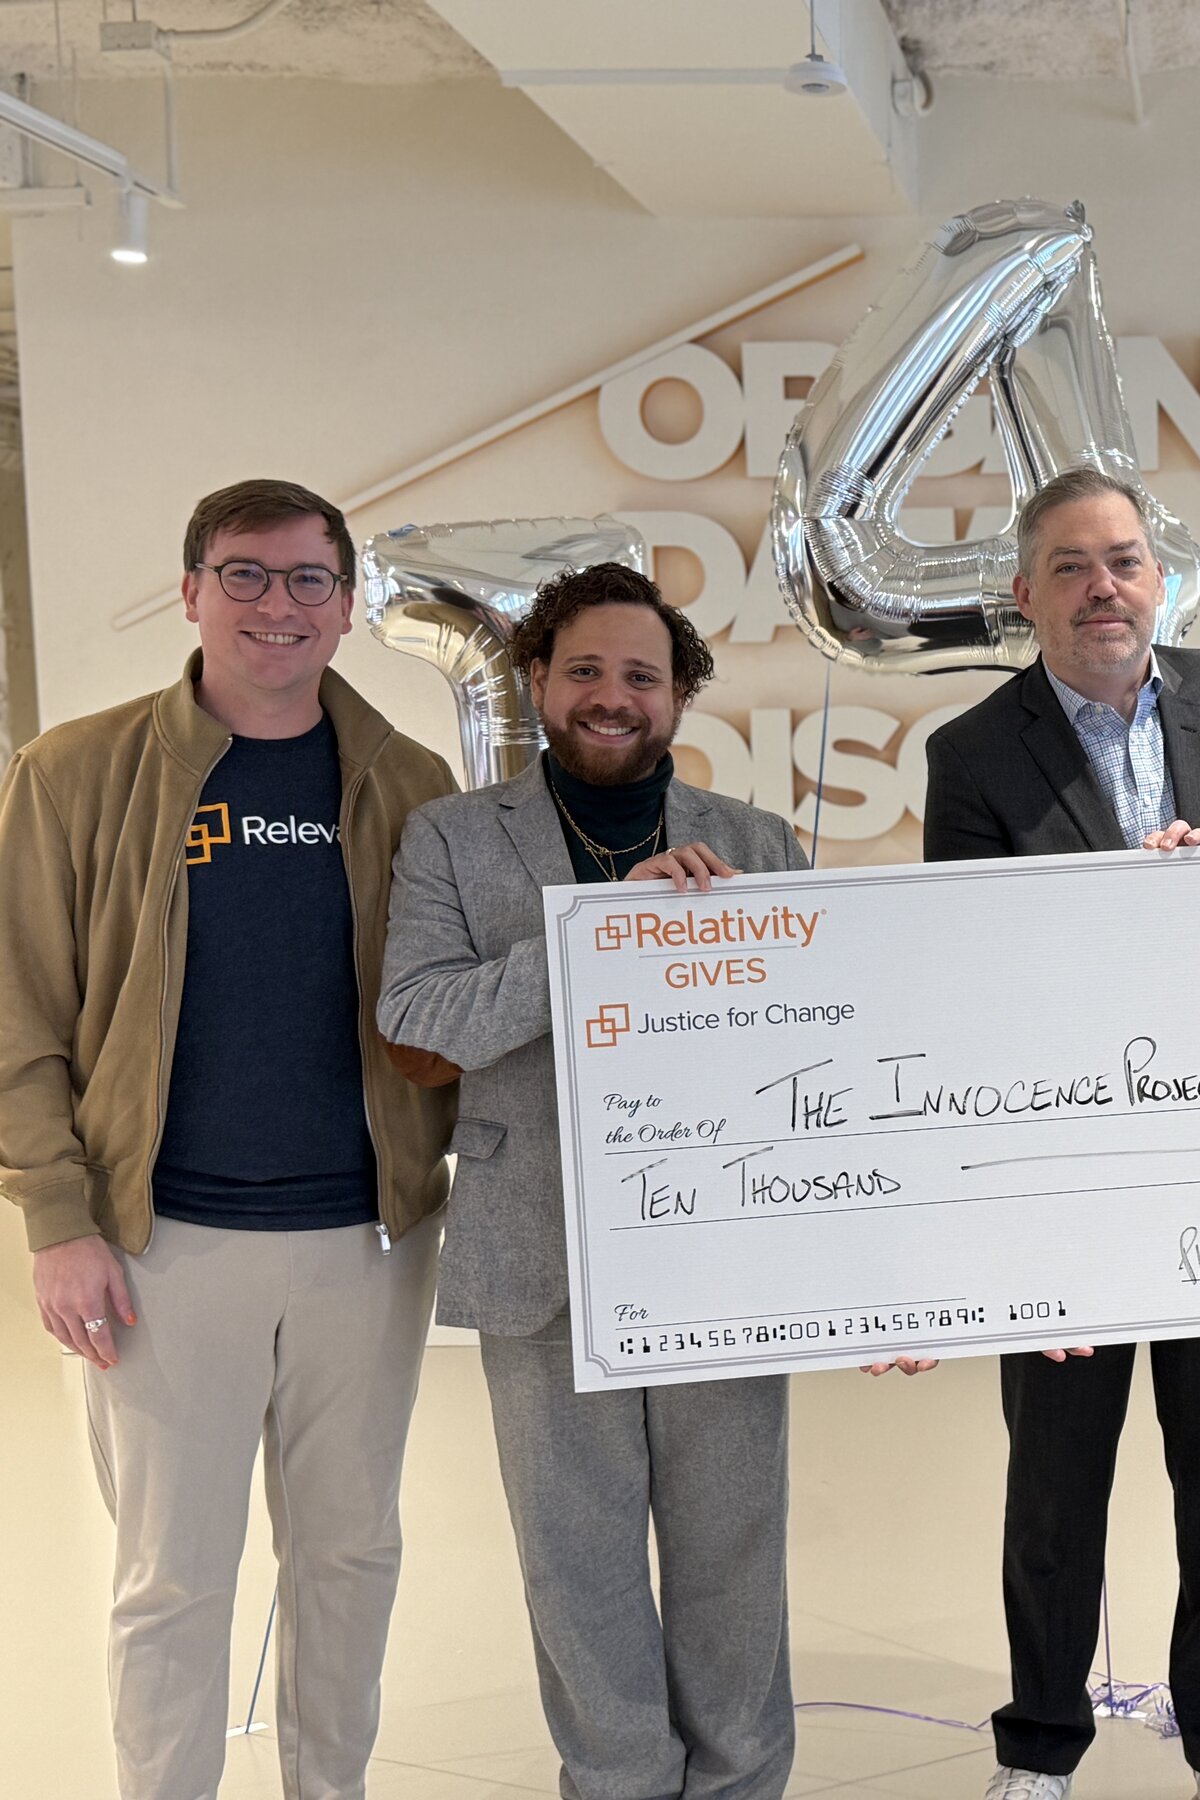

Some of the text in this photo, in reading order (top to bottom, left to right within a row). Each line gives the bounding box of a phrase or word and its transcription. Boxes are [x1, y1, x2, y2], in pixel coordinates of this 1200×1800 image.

[664, 956, 768, 990] GIVES
[637, 1001, 856, 1035] Justice for Change
[603, 1092, 664, 1118] Pay to
[755, 1058, 854, 1133] THE
[868, 1052, 1113, 1121] INNOCENCE
[605, 1117, 727, 1144] the Order Of
[620, 1145, 902, 1222] TEN THOUSAND
[613, 1303, 649, 1322] For
[1008, 1300, 1067, 1322] 1001
